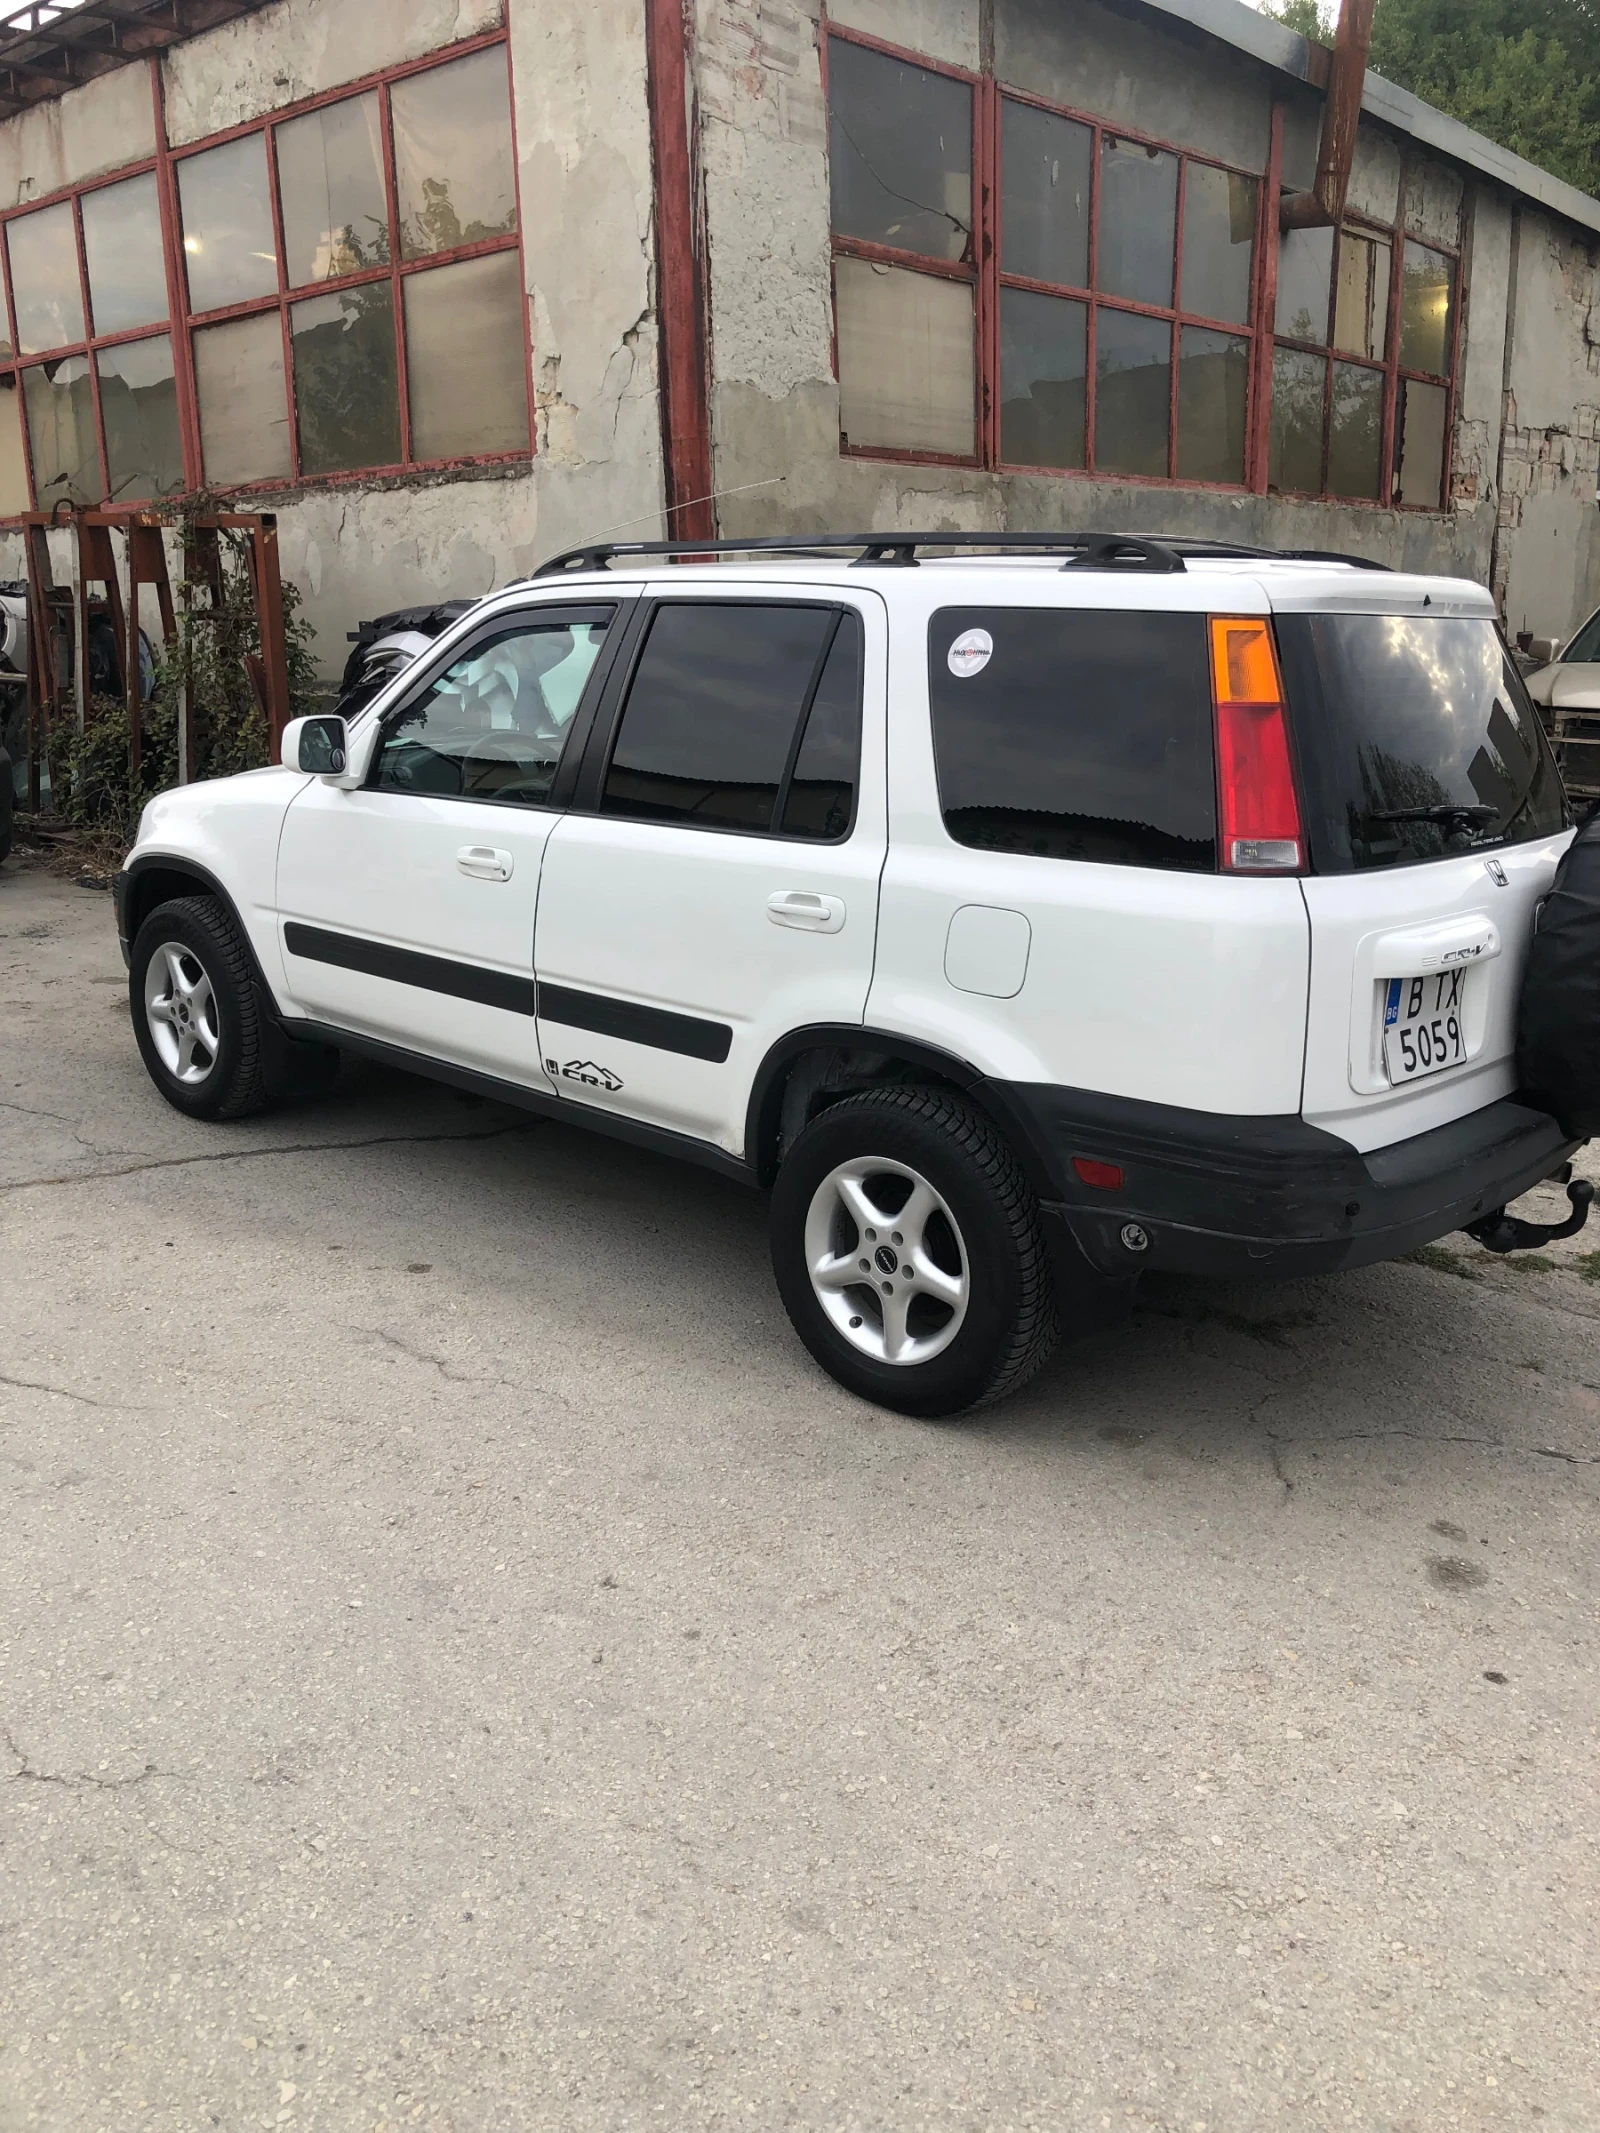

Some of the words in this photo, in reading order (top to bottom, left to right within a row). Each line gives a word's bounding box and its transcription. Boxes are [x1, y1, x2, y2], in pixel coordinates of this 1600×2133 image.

[1441, 943, 1487, 964] CR-V
[1407, 976, 1424, 1019] B
[1435, 966, 1463, 1012] TX
[1386, 1005, 1398, 1020] BG
[1400, 1016, 1460, 1072] 5059
[562, 1067, 625, 1092] CR-V
